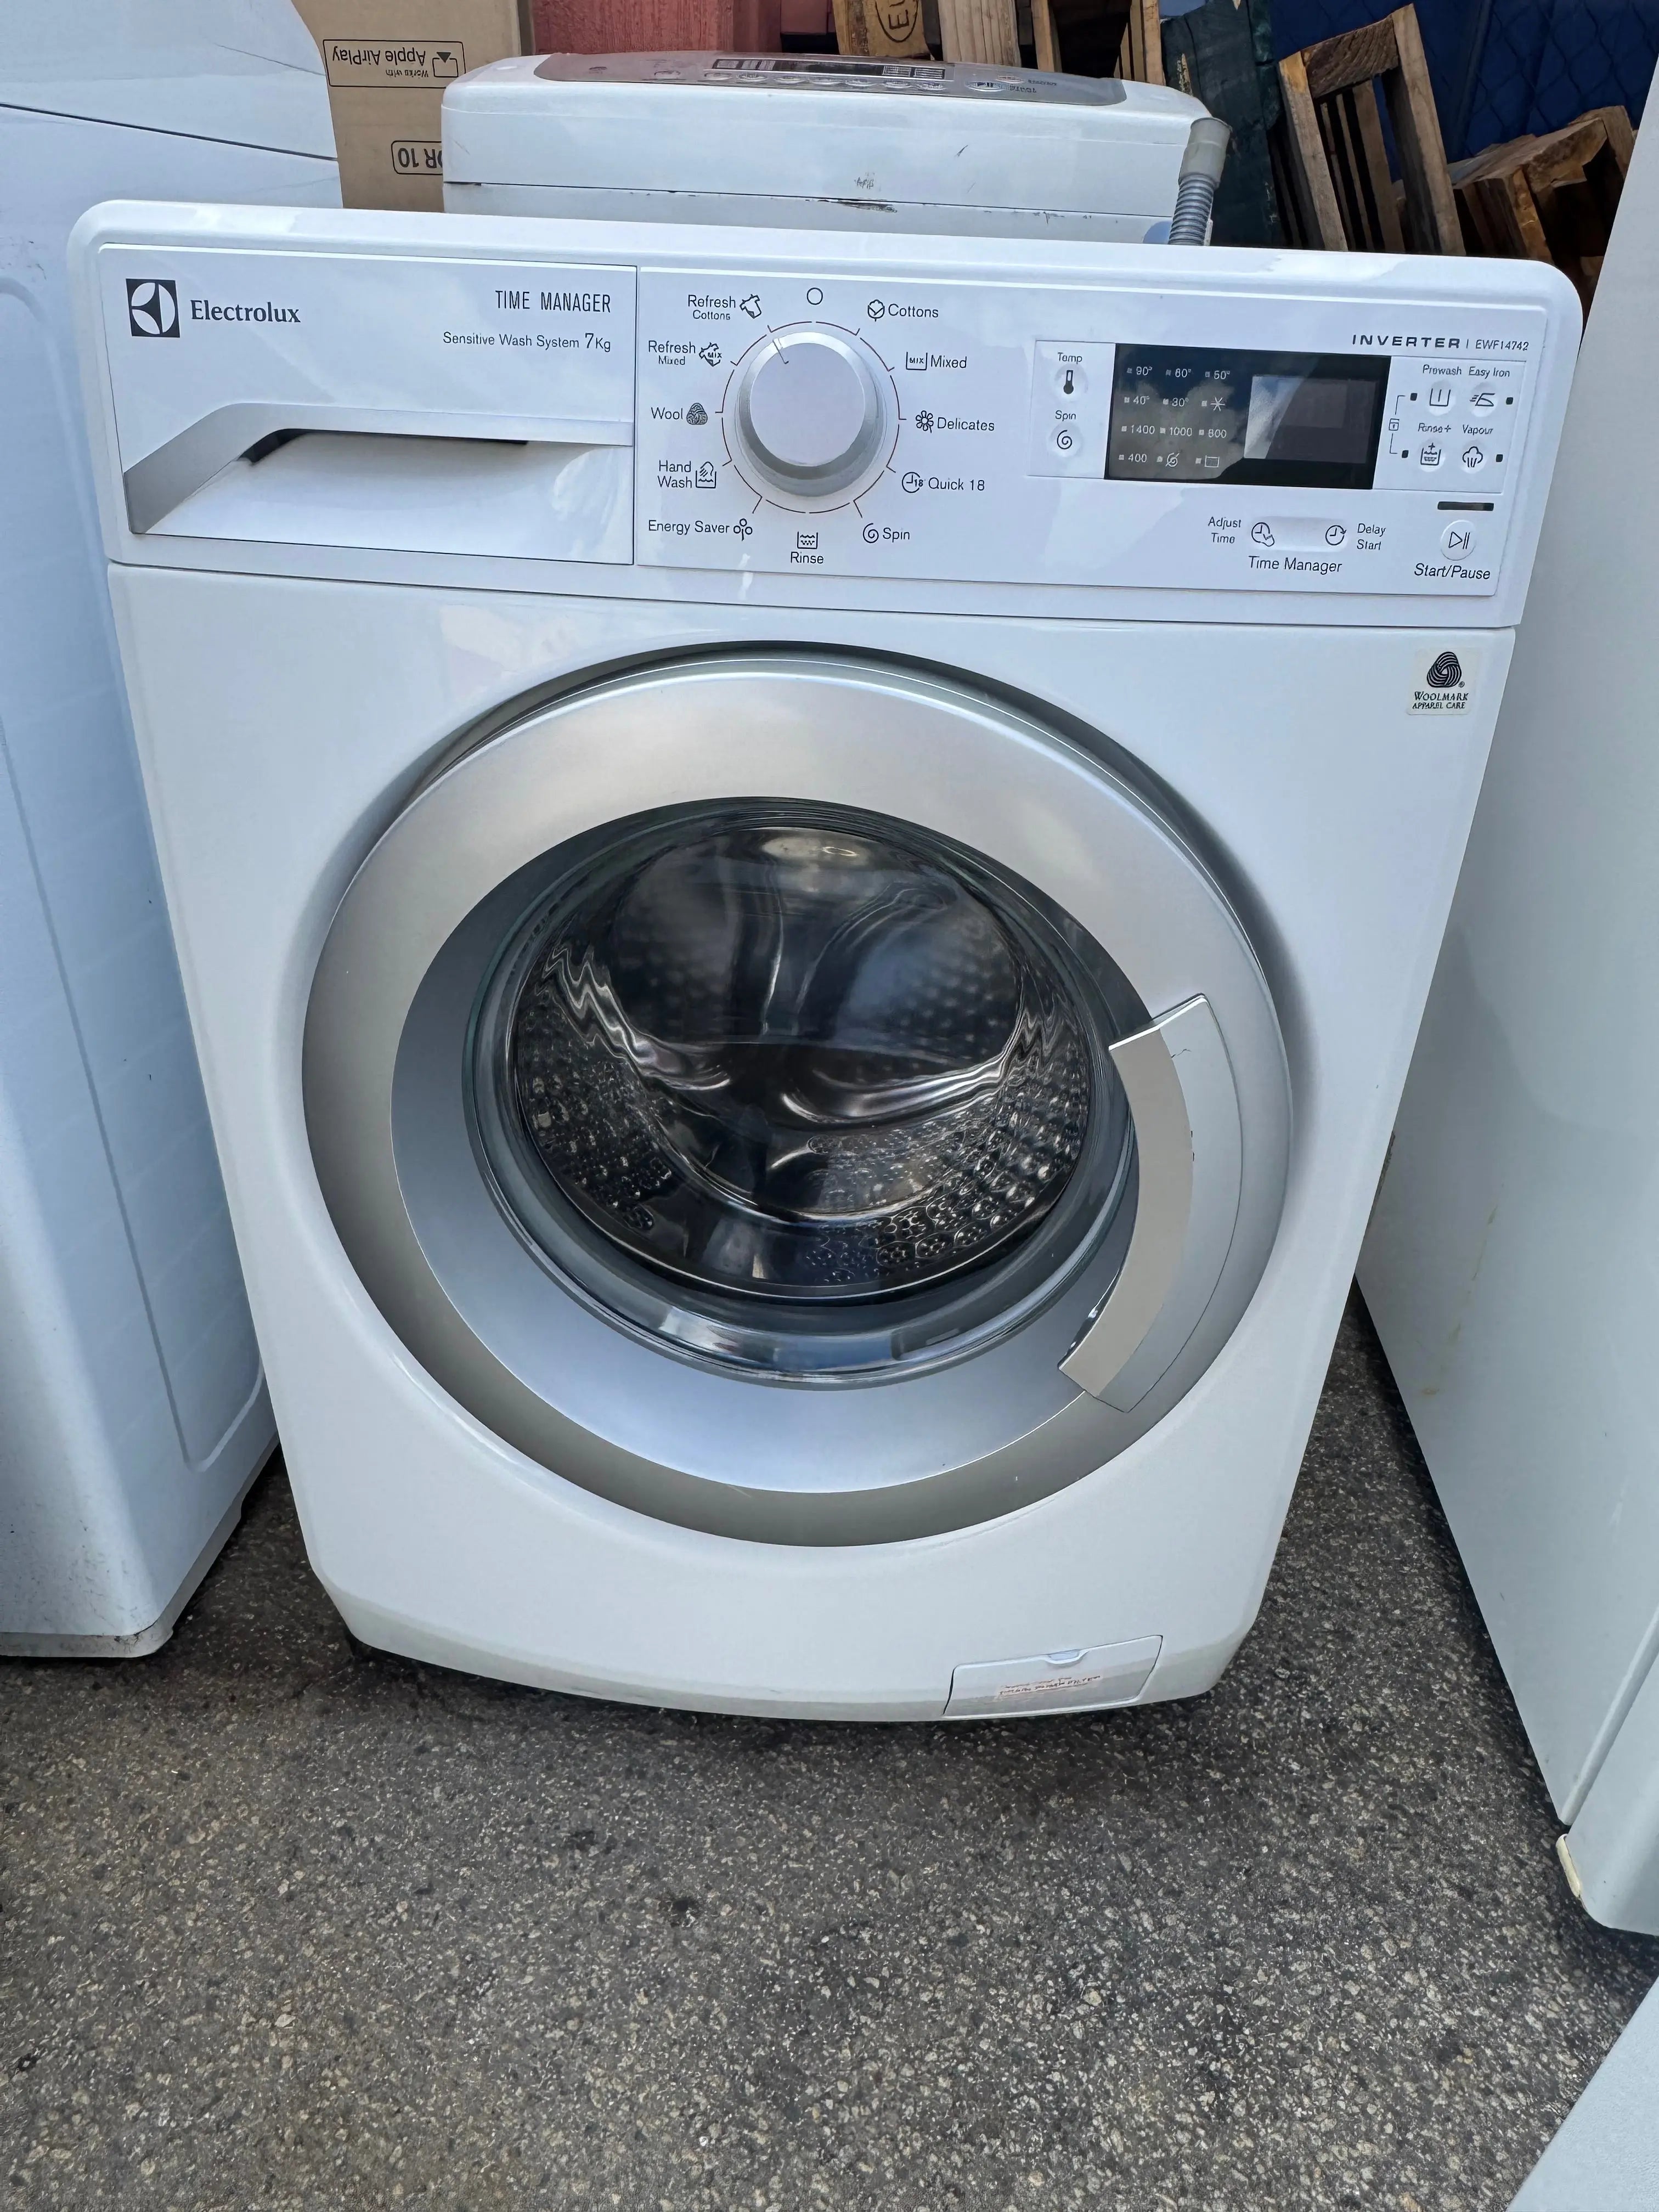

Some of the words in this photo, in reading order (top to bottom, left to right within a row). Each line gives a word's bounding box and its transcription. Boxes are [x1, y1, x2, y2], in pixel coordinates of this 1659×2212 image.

[332, 46, 380, 65] AirPlay
[385, 47, 426, 66] Apple
[385, 69, 402, 77] with
[404, 69, 429, 78] Works
[398, 147, 419, 167] 10
[495, 290, 530, 309] TIME
[540, 291, 611, 313] MANAGER
[687, 295, 736, 309] Refresh
[190, 299, 301, 323] Electrolux
[692, 309, 731, 320] Cottons
[888, 304, 939, 318] Cottons
[443, 332, 495, 346] Sensitive
[499, 334, 532, 347] Wash
[536, 335, 580, 350] System
[584, 332, 611, 352] 7Kg
[648, 341, 696, 356] Refresh
[1352, 334, 1460, 348] INVERTER
[1475, 339, 1530, 351] EWF14742
[658, 355, 685, 366] Mixed
[931, 357, 967, 369] Mixed
[1058, 352, 1082, 364] Temp
[1423, 364, 1462, 375] Prewash
[1469, 366, 1490, 379] Easy
[1492, 367, 1510, 377] Iron
[651, 407, 683, 420] Wool
[1055, 410, 1076, 421] Spin
[938, 418, 995, 432] Delicates
[1131, 425, 1155, 435] 1400
[1169, 426, 1192, 437] 1000
[1463, 424, 1493, 436] Vapour
[1128, 453, 1147, 462] 400
[659, 461, 691, 473] Hand
[658, 476, 692, 489] Wash
[928, 476, 965, 491] Quick
[969, 478, 985, 491] 18
[648, 521, 691, 535] Energy
[694, 521, 730, 534] Saver
[1207, 516, 1242, 529] Adjust
[883, 528, 910, 541] Spin
[1357, 522, 1386, 537] Delay
[1211, 532, 1235, 544] Time
[1356, 539, 1381, 551] Start
[791, 552, 823, 565] Rinse
[1248, 555, 1279, 569] Time
[1284, 557, 1342, 573] Manager
[1414, 563, 1491, 580] Start/Pause
[1414, 691, 1469, 701] WOOLMARK
